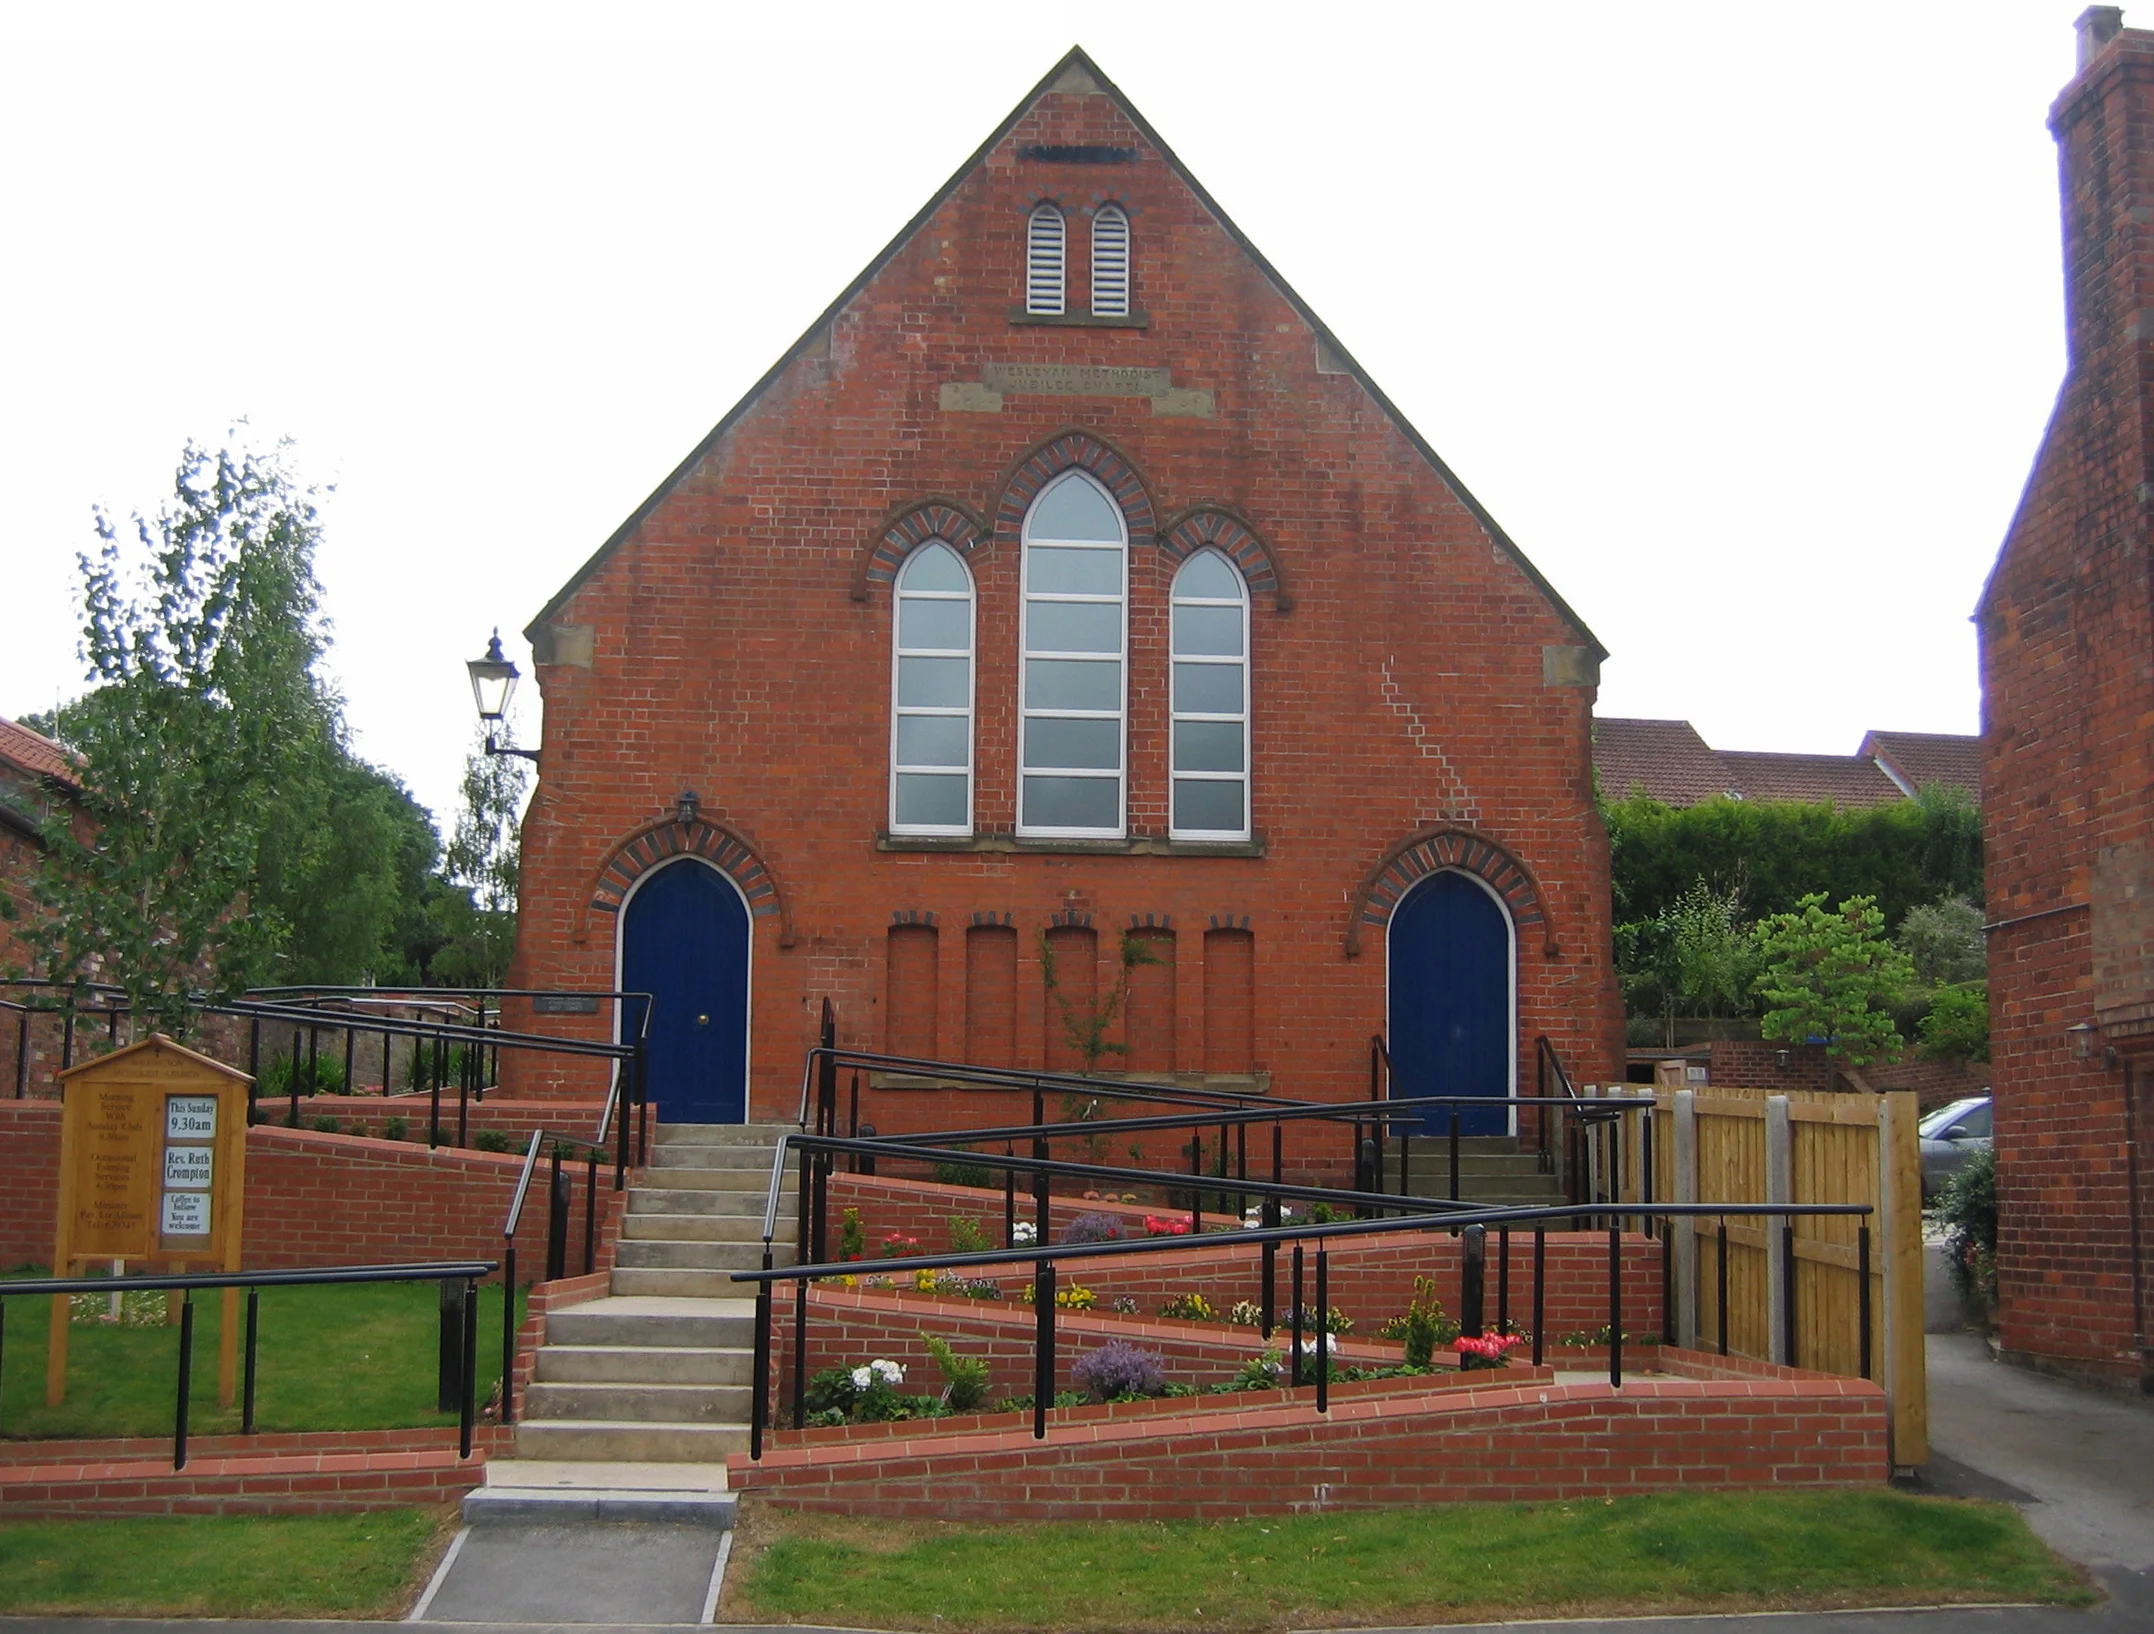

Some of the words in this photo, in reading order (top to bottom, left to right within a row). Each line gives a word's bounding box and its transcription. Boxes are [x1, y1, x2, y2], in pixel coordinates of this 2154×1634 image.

[994, 366, 1072, 378] WESLEYAN
[1080, 368, 1160, 380] METHODIST
[1010, 380, 1073, 391] JUBILEE
[164, 1070, 200, 1078] CHURCH
[99, 1092, 134, 1102] Morning
[171, 1102, 186, 1113] This
[188, 1102, 213, 1115] Sunday
[87, 1122, 117, 1132] Sunday
[171, 1117, 211, 1130] 9.30am
[189, 1152, 210, 1164] Ruth
[167, 1164, 210, 1181] Crompton
[171, 1194, 191, 1204] Coffee
[171, 1212, 184, 1221] You
[169, 1221, 201, 1230] welcome
